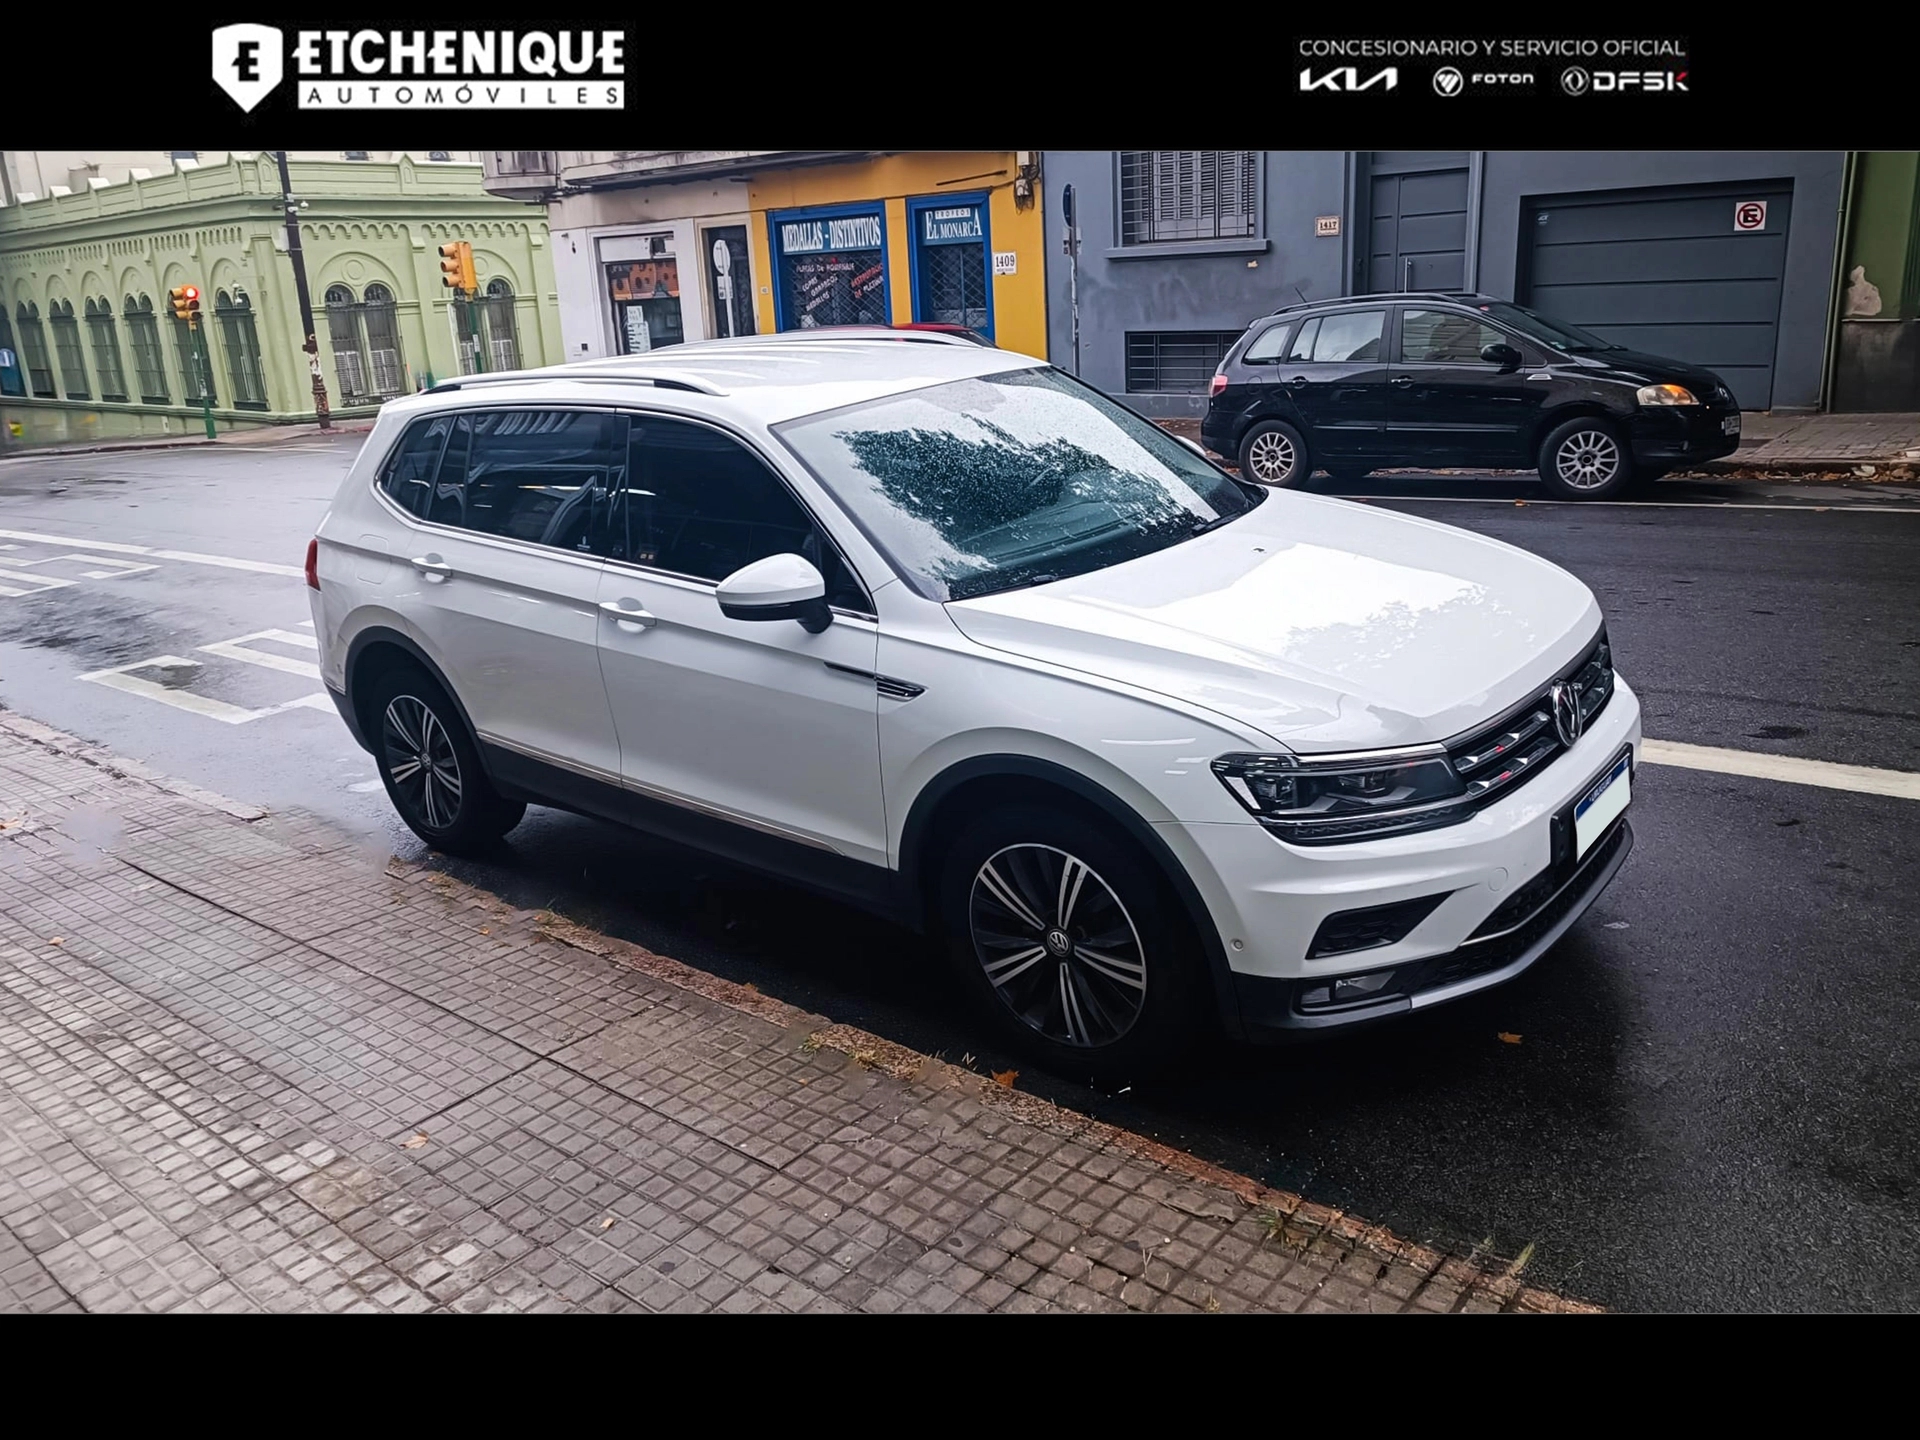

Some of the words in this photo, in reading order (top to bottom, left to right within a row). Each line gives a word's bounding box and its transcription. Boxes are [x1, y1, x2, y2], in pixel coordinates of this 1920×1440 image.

[782, 221, 824, 253] MEDALLAS
[828, 216, 881, 249] DISTINTIVOS
[940, 208, 982, 239] MONARCA
[1320, 221, 1337, 229] 1417
[995, 255, 1015, 268] 1409
